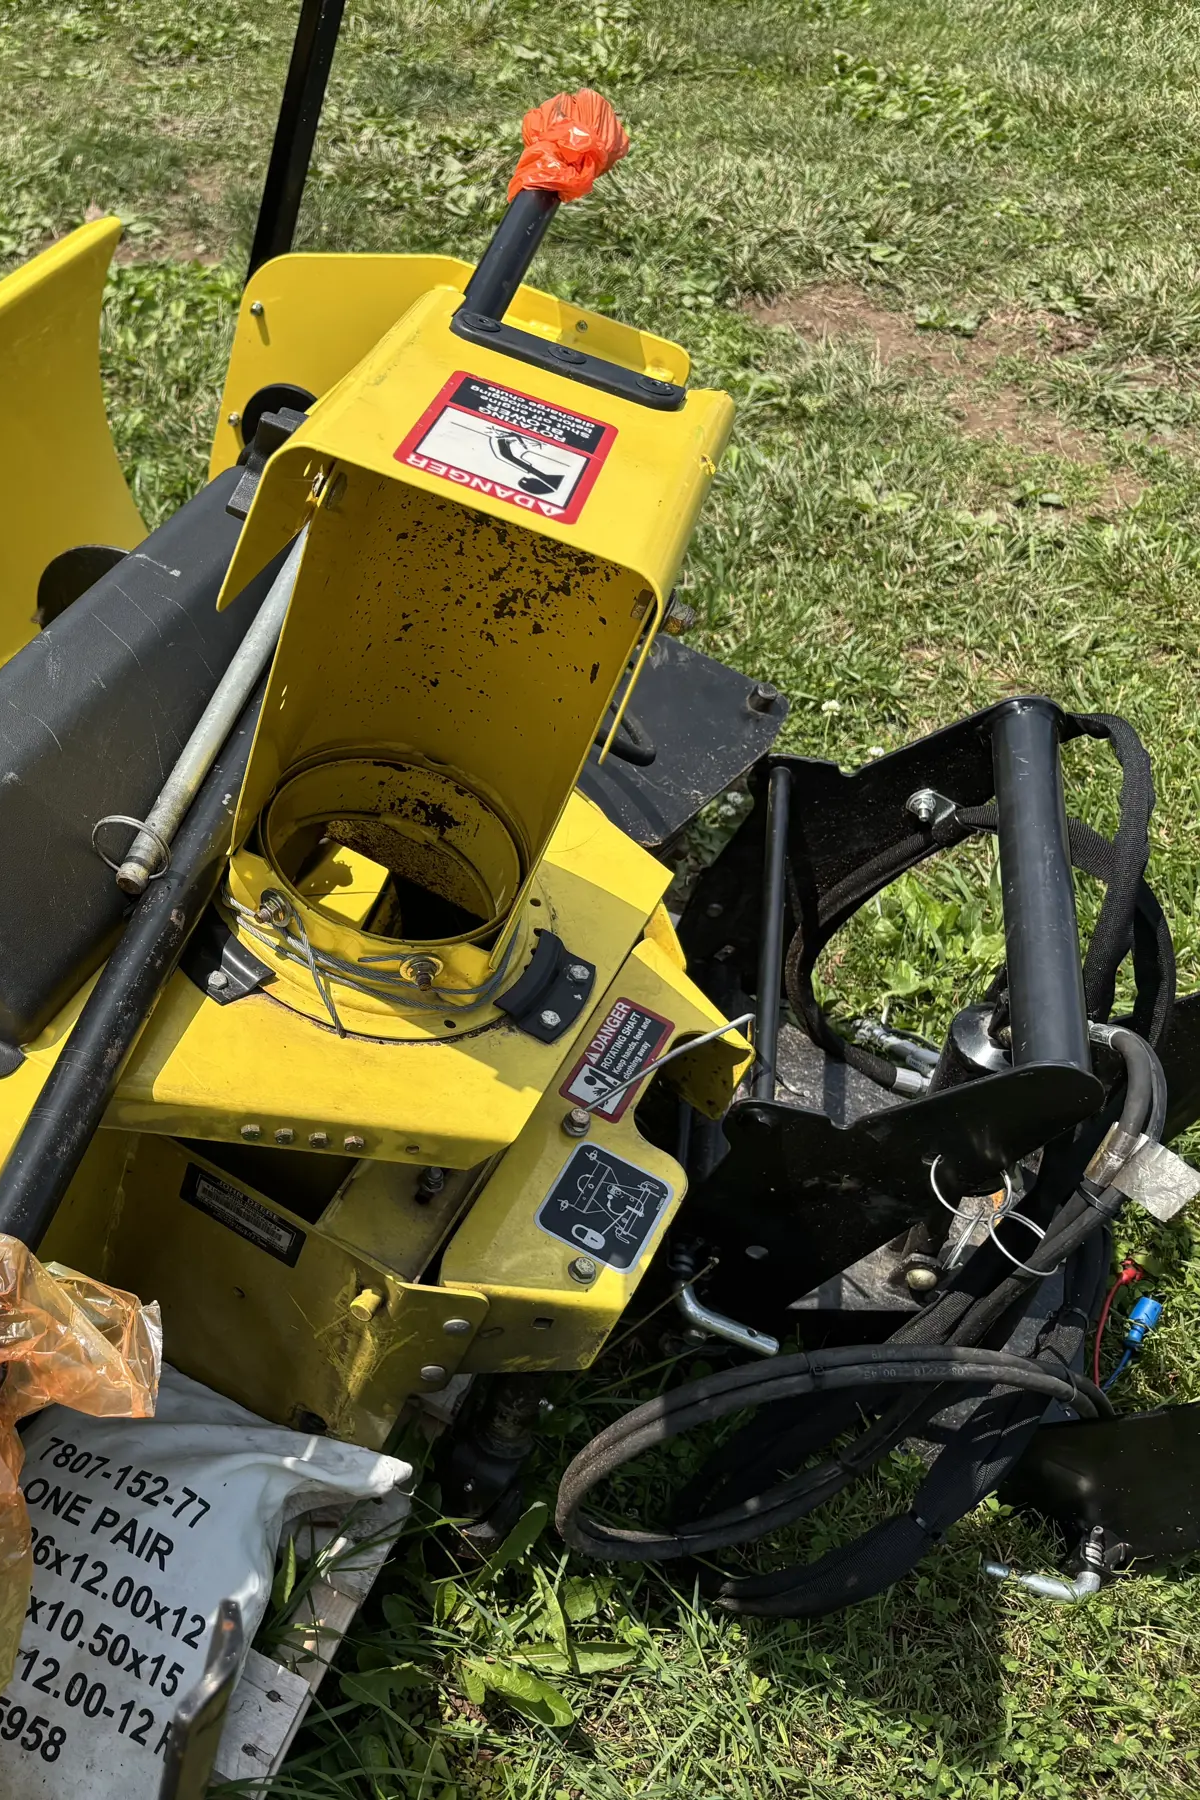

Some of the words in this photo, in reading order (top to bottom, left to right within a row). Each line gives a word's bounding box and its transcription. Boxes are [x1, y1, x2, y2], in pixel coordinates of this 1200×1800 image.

[470, 384, 545, 416] unclogging
[480, 394, 528, 415] engine
[487, 386, 525, 403] chute
[478, 406, 566, 443] ROTATING
[486, 403, 564, 436] BLOWER
[528, 401, 596, 428] discharge
[531, 414, 552, 425] off
[549, 414, 593, 434] before
[555, 422, 591, 439] Shut
[406, 453, 540, 510] DANGER
[590, 1001, 631, 1052] DANGER
[600, 1034, 628, 1070] ROTATING
[621, 1011, 641, 1036] SHAFT
[612, 1059, 627, 1075] Keep
[621, 1041, 639, 1060] hands,
[633, 1028, 644, 1041] feet
[641, 1017, 652, 1031] and
[623, 1055, 643, 1080] clothing
[637, 1040, 652, 1058] away
[39, 1437, 211, 1530] 7807-152-77
[24, 1478, 92, 1527] ONE
[91, 1507, 175, 1572] PAIR
[25, 1585, 185, 1697] x10.50x15
[16, 1648, 154, 1746] 12.00-12
